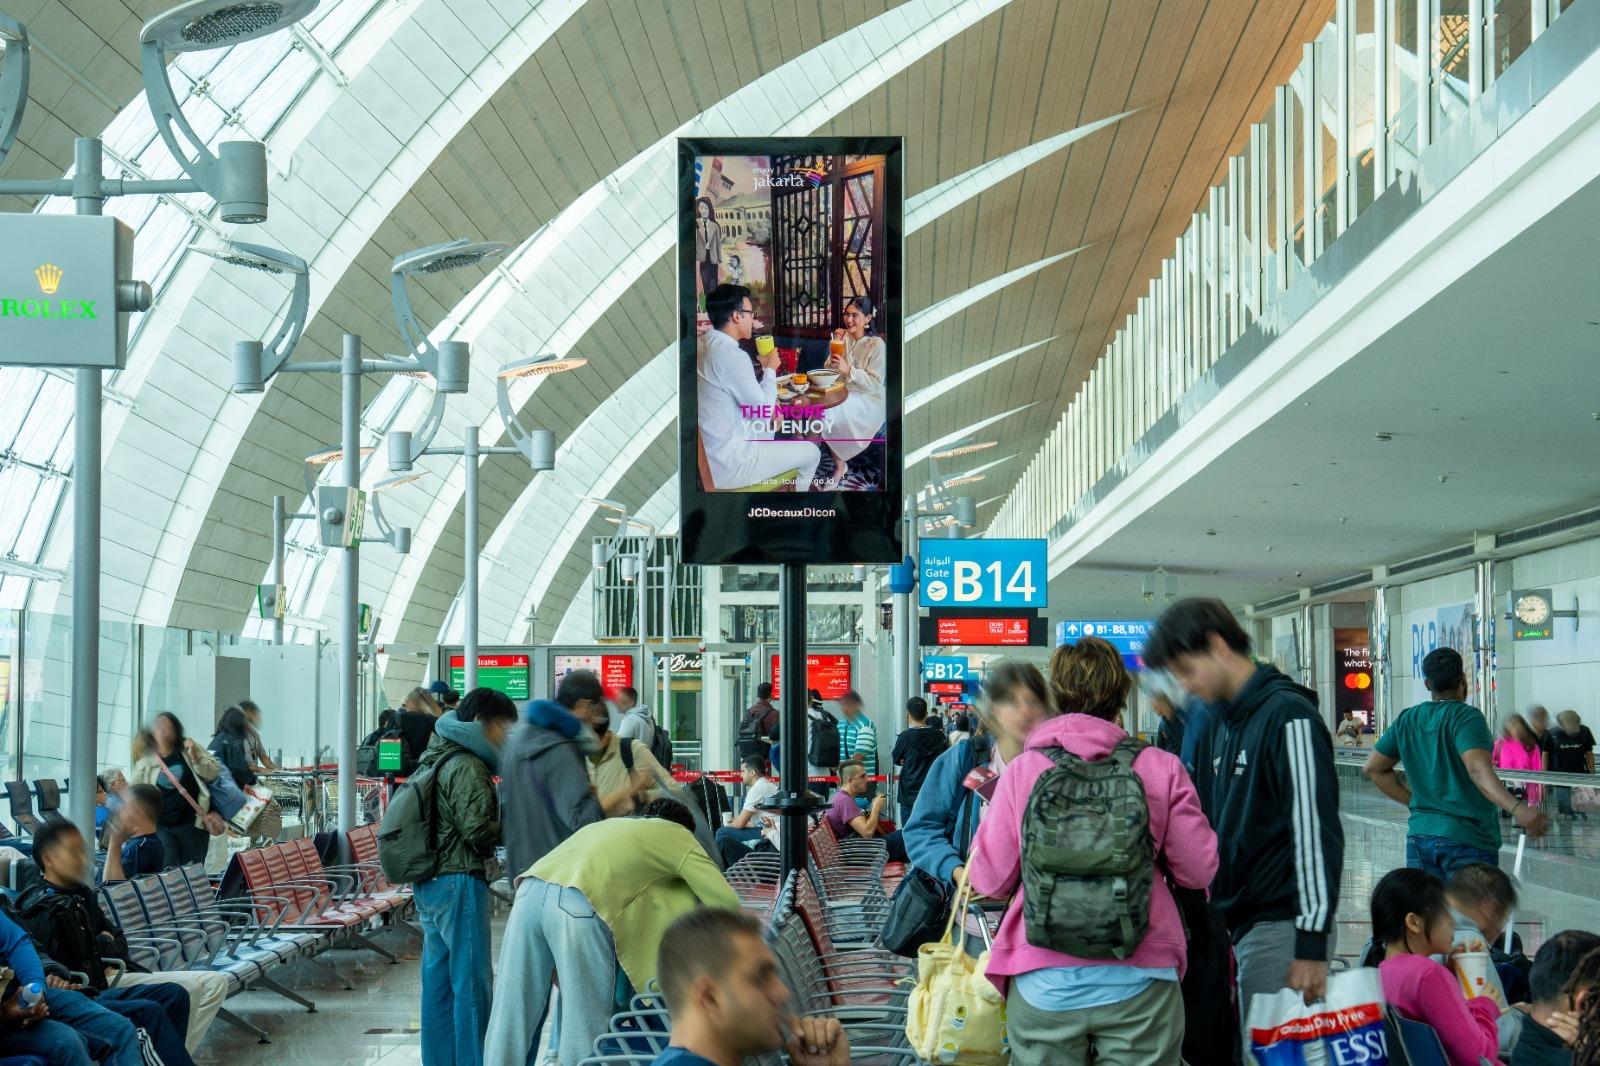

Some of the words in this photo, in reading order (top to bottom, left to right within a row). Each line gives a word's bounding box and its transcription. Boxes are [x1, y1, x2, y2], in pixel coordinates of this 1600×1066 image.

[752, 174, 804, 191] jakarta
[1, 298, 98, 320] ROLEX
[740, 404, 771, 418] THE
[774, 404, 826, 419] MORE
[740, 420, 778, 433] YOU
[781, 420, 834, 434] ENJOY
[925, 568, 950, 578] Gate
[953, 560, 1037, 602] B14
[1344, 648, 1360, 657] The
[935, 663, 964, 679] B12
[1344, 660, 1367, 668] what
